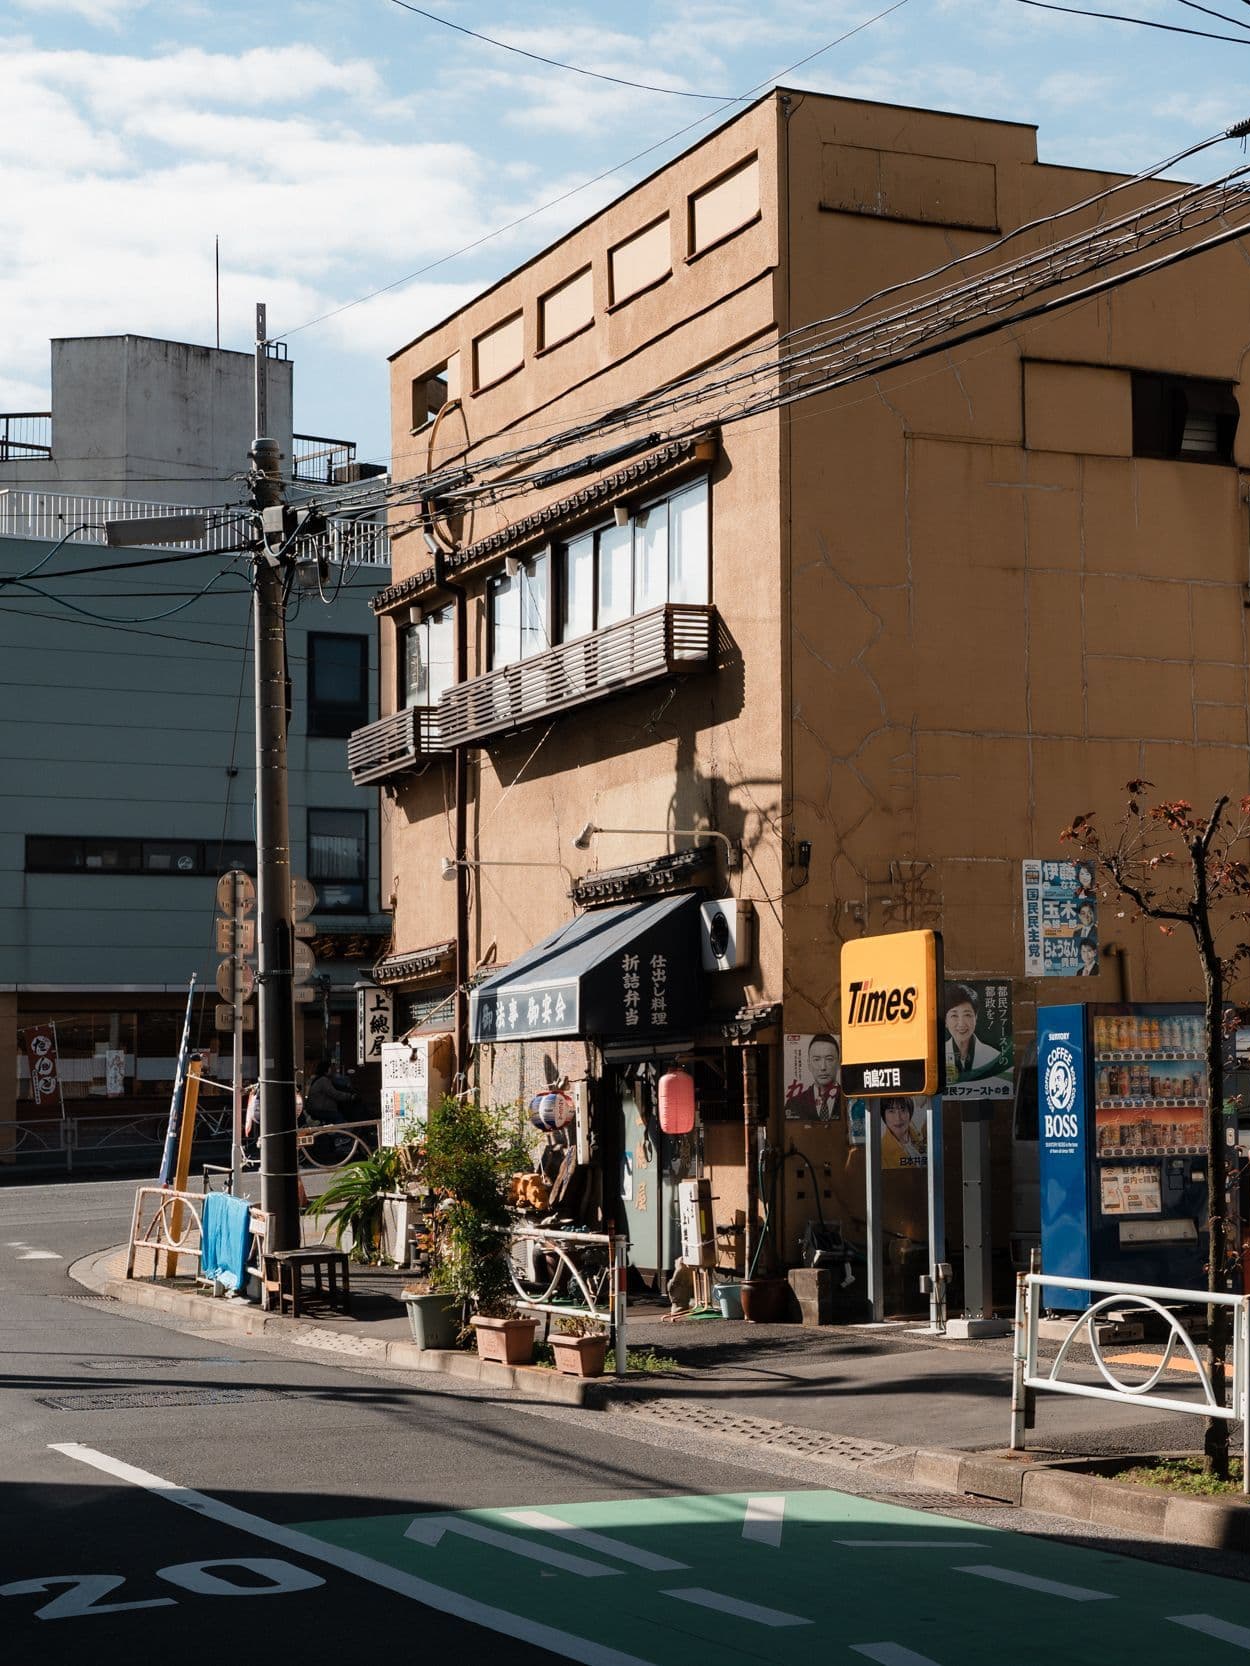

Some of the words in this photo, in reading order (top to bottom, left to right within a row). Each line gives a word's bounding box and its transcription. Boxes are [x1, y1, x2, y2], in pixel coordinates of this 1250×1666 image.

[1026, 888, 1040, 958] 国民民主党
[1043, 900, 1077, 919] 玉木
[1045, 940, 1078, 958] ちょうなん
[622, 954, 641, 1026] 折詰弁当
[649, 954, 669, 1026] 仕出し料理
[847, 978, 916, 1028] Times
[481, 996, 519, 1031] 御法事
[526, 991, 567, 1027] 御宴会
[997, 985, 1009, 1066] 都民ファーストの
[1047, 1046, 1073, 1067] COFFEE
[863, 1068, 901, 1088] 向島2丁目
[1044, 1114, 1078, 1138] BOSS
[899, 1156, 928, 1166] 日本共産
[2, 1557, 326, 1620] 20
